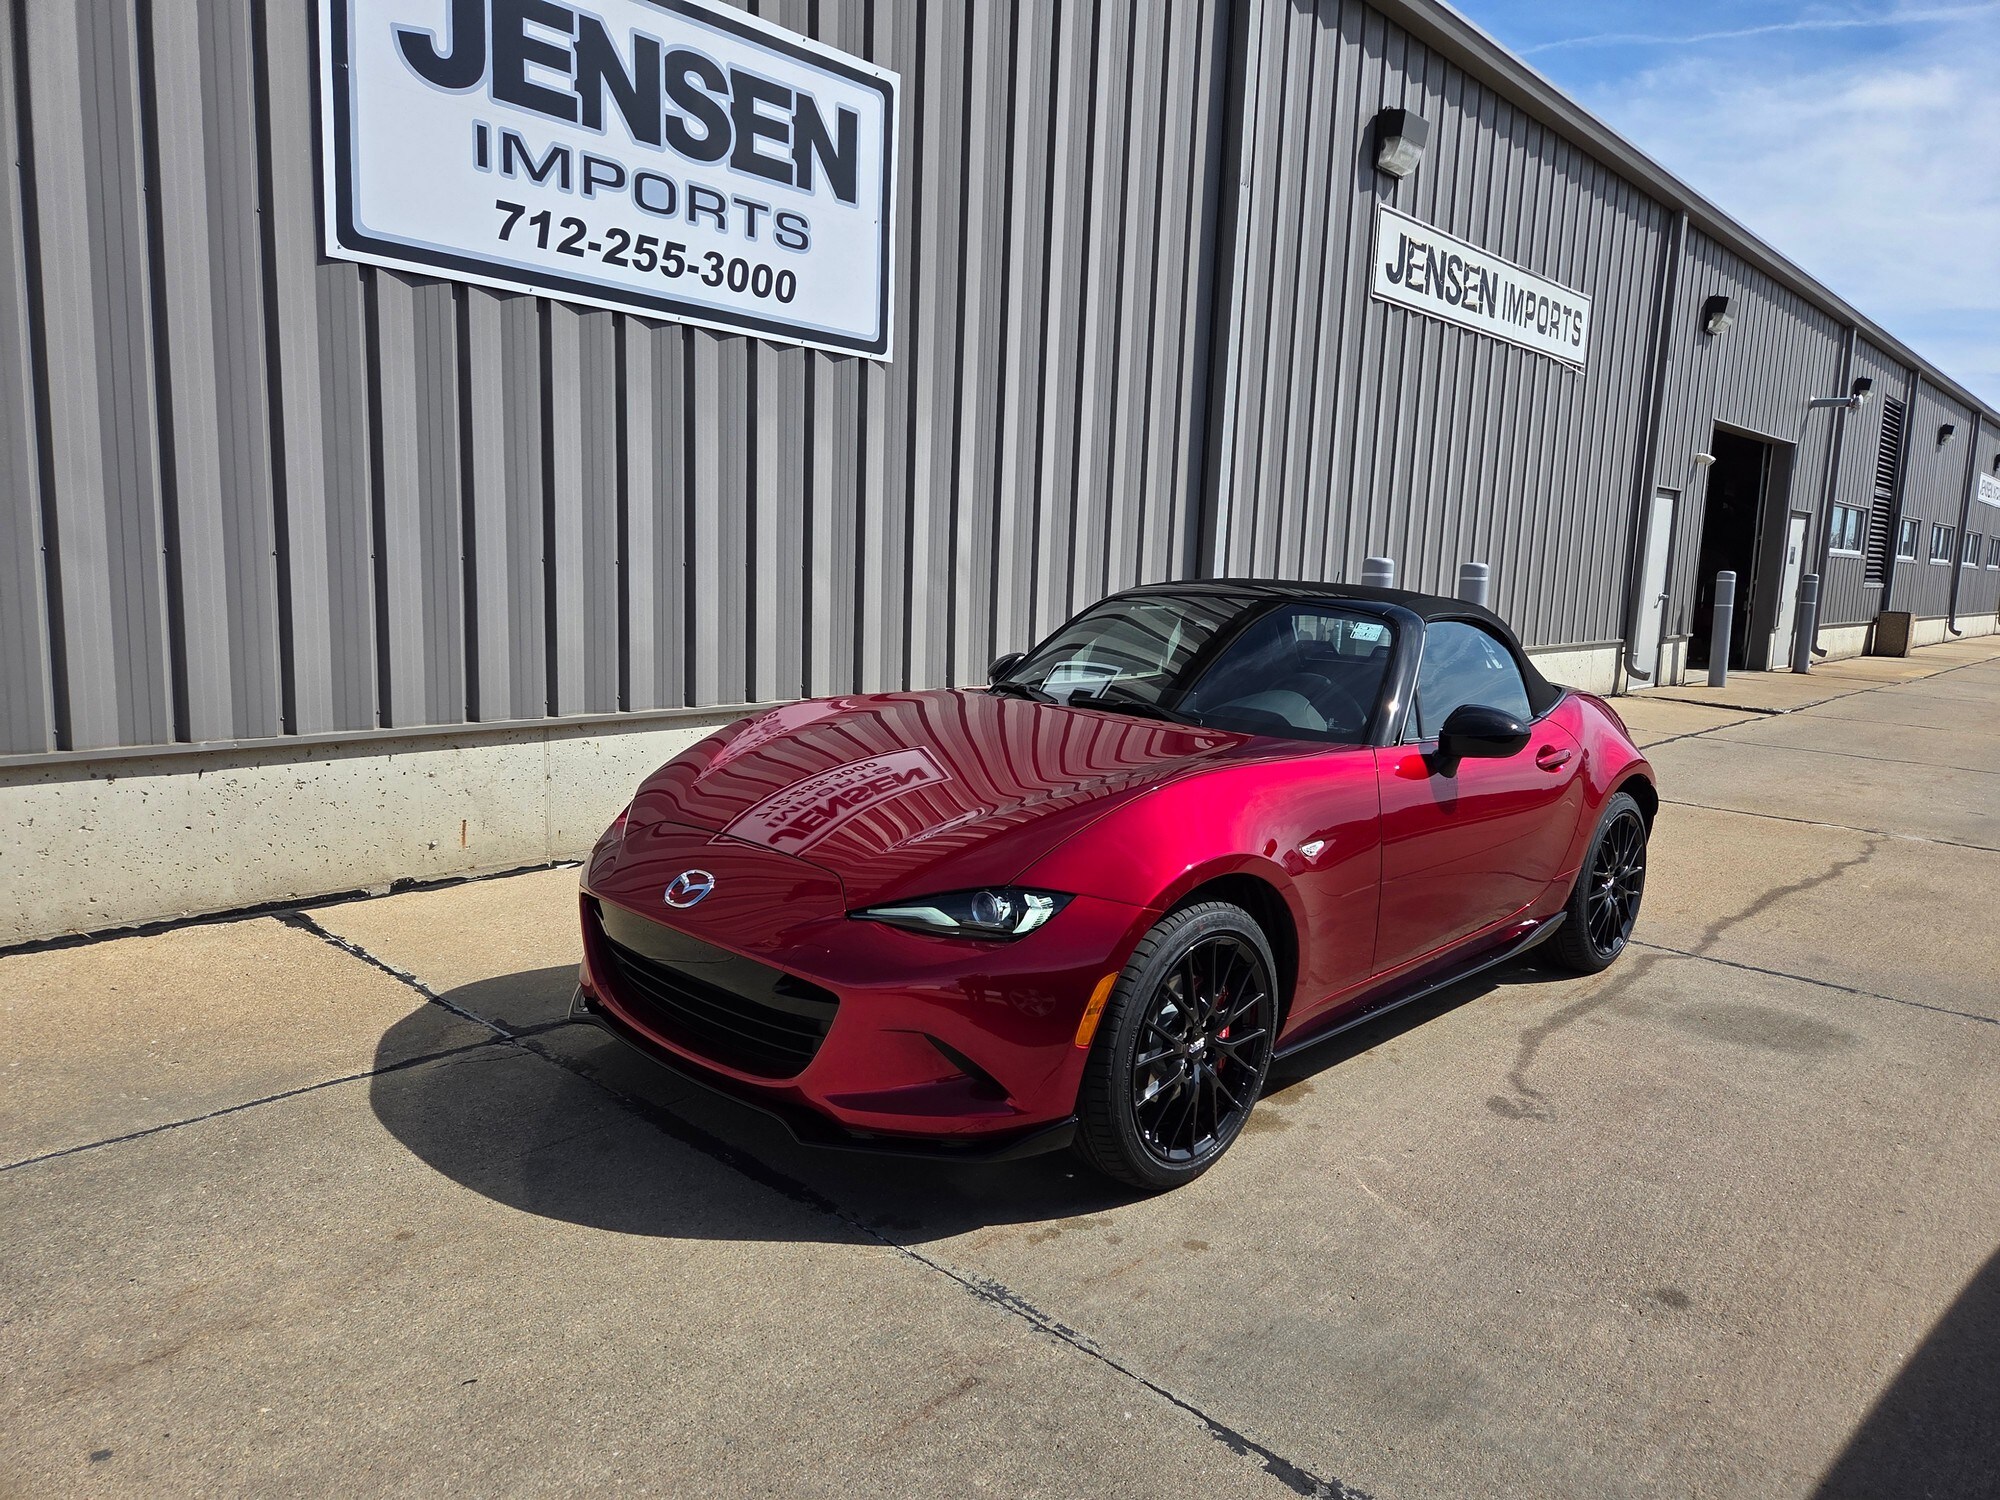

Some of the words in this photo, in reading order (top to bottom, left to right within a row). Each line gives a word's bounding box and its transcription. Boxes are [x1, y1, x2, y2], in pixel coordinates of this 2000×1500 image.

[395, 0, 858, 206] JENSEN
[475, 122, 811, 252] IMPORTS
[495, 199, 797, 304] 712-255-3000
[1385, 232, 1499, 319] JENSEN
[1502, 280, 1583, 347] IMPORTS
